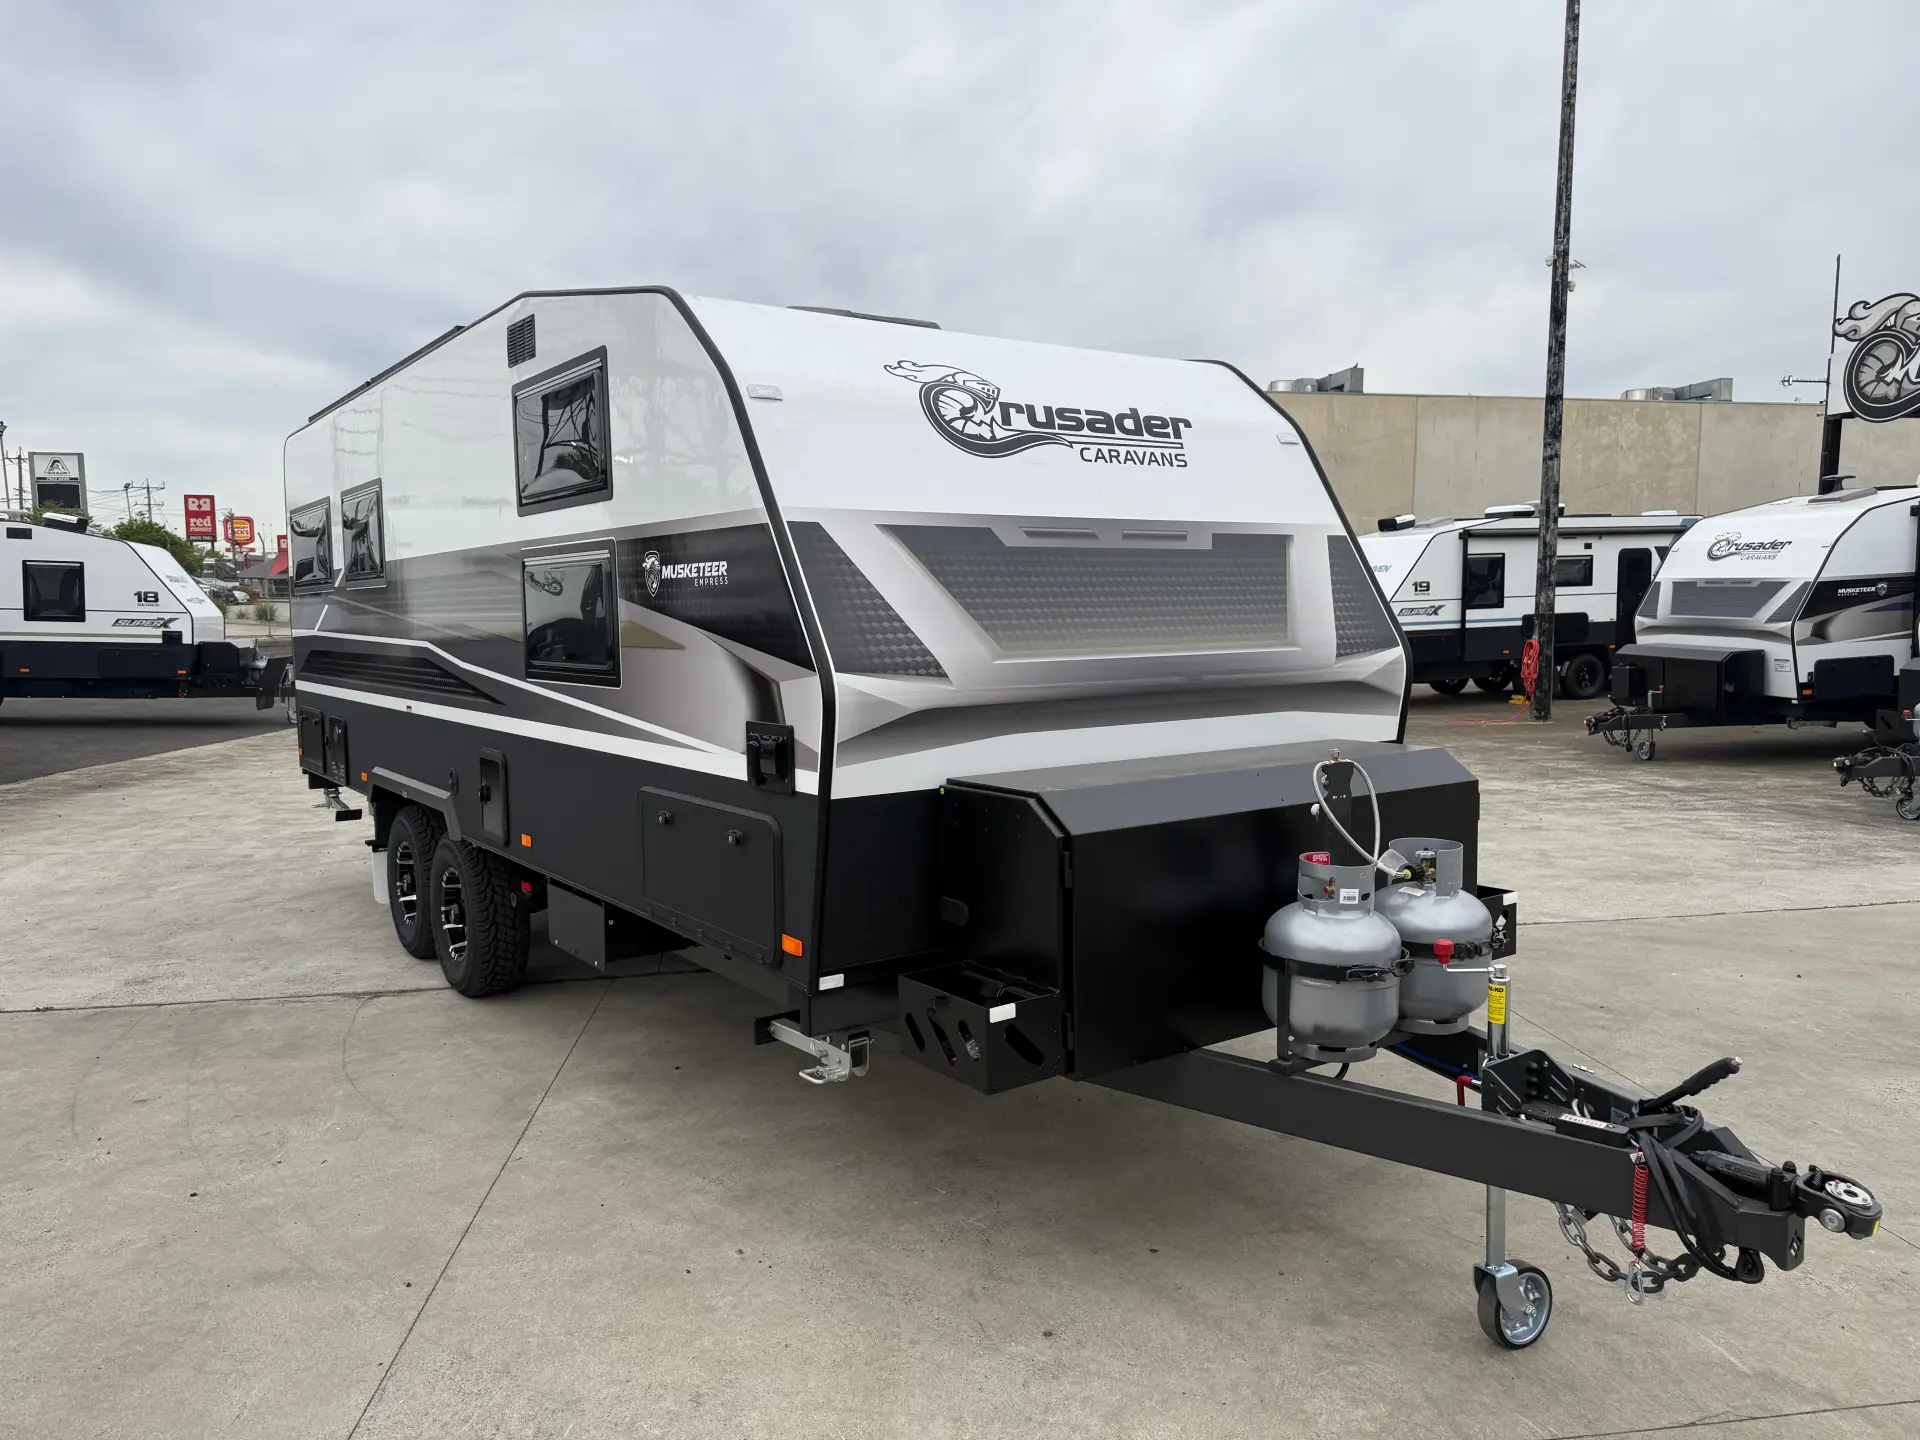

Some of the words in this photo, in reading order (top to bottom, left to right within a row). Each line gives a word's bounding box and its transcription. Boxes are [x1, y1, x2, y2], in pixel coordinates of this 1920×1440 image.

[1080, 446, 1188, 468] CARAVANS
[189, 516, 212, 527] red
[661, 560, 728, 579] MUSKETEER
[1412, 581, 1430, 592] 19
[134, 591, 159, 603] 18
